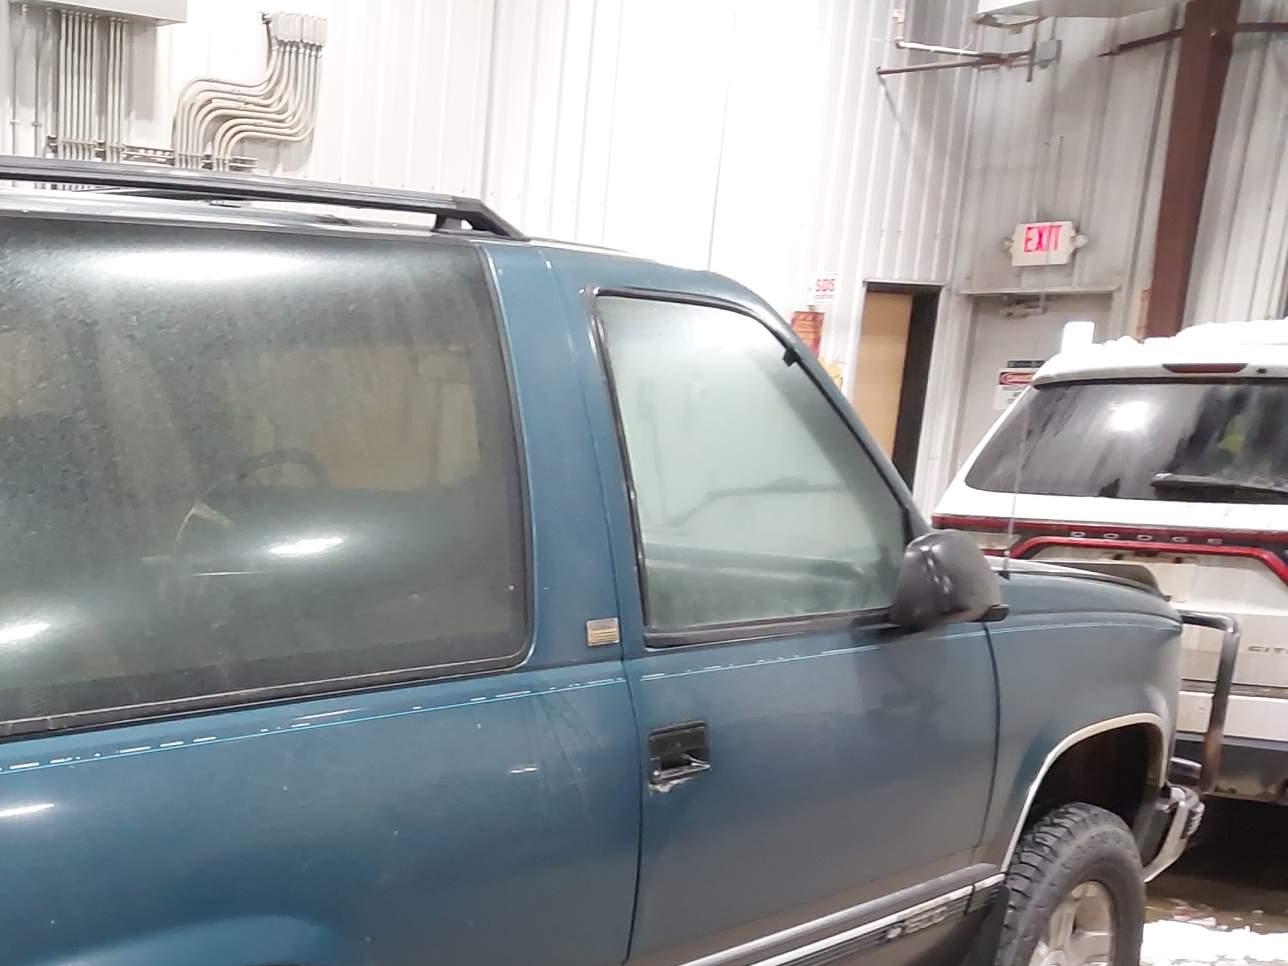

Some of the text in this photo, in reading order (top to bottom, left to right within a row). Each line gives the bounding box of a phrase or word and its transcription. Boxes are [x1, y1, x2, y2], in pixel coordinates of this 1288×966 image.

[1023, 224, 1063, 253] EXIT
[1070, 531, 1223, 546] DODGE
[1247, 645, 1288, 654] CIT
